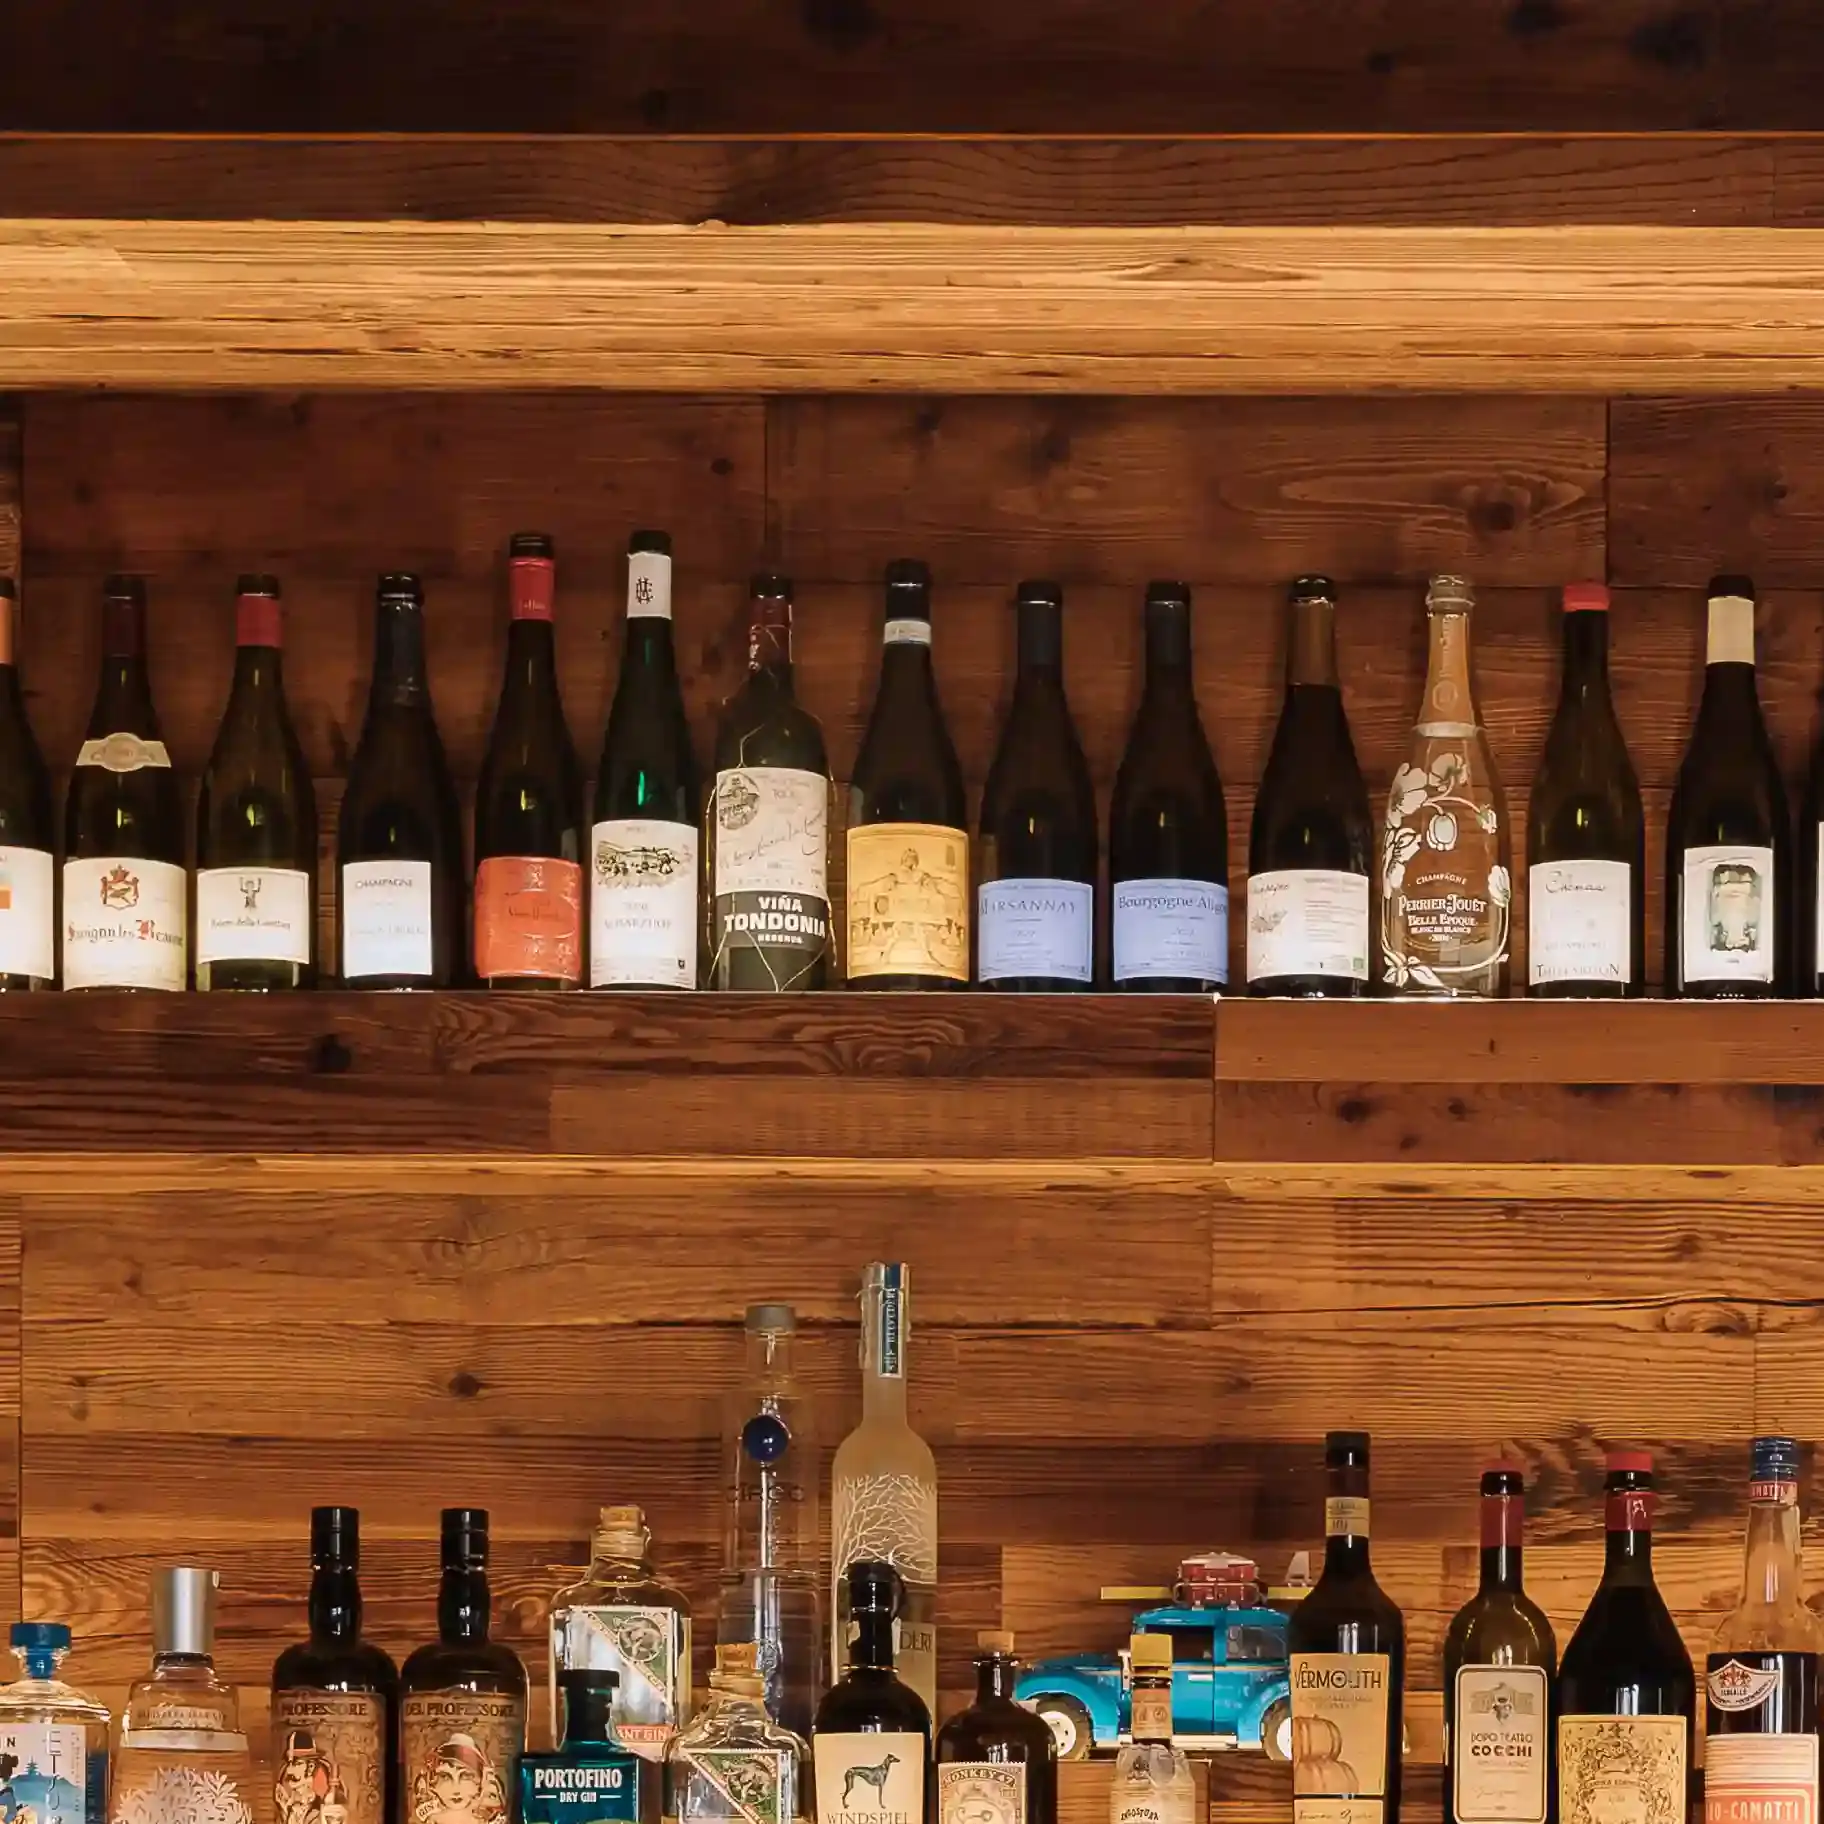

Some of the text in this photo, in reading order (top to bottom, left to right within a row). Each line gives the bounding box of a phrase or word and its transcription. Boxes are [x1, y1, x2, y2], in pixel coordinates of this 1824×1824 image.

[1415, 871, 1468, 885] CHAMPAGNE
[758, 896, 803, 914] VIÑA
[1118, 894, 1193, 911] Bourgogne
[724, 913, 825, 937] TONDONIA
[1407, 914, 1438, 926] BELLE
[643, 1727, 668, 1741] GIN
[1471, 1732, 1534, 1743] DOPO TEATRO
[1471, 1744, 1533, 1758] COCCHI
[533, 1768, 623, 1789] PORTOFINO
[558, 1791, 597, 1803] DRY GIN
